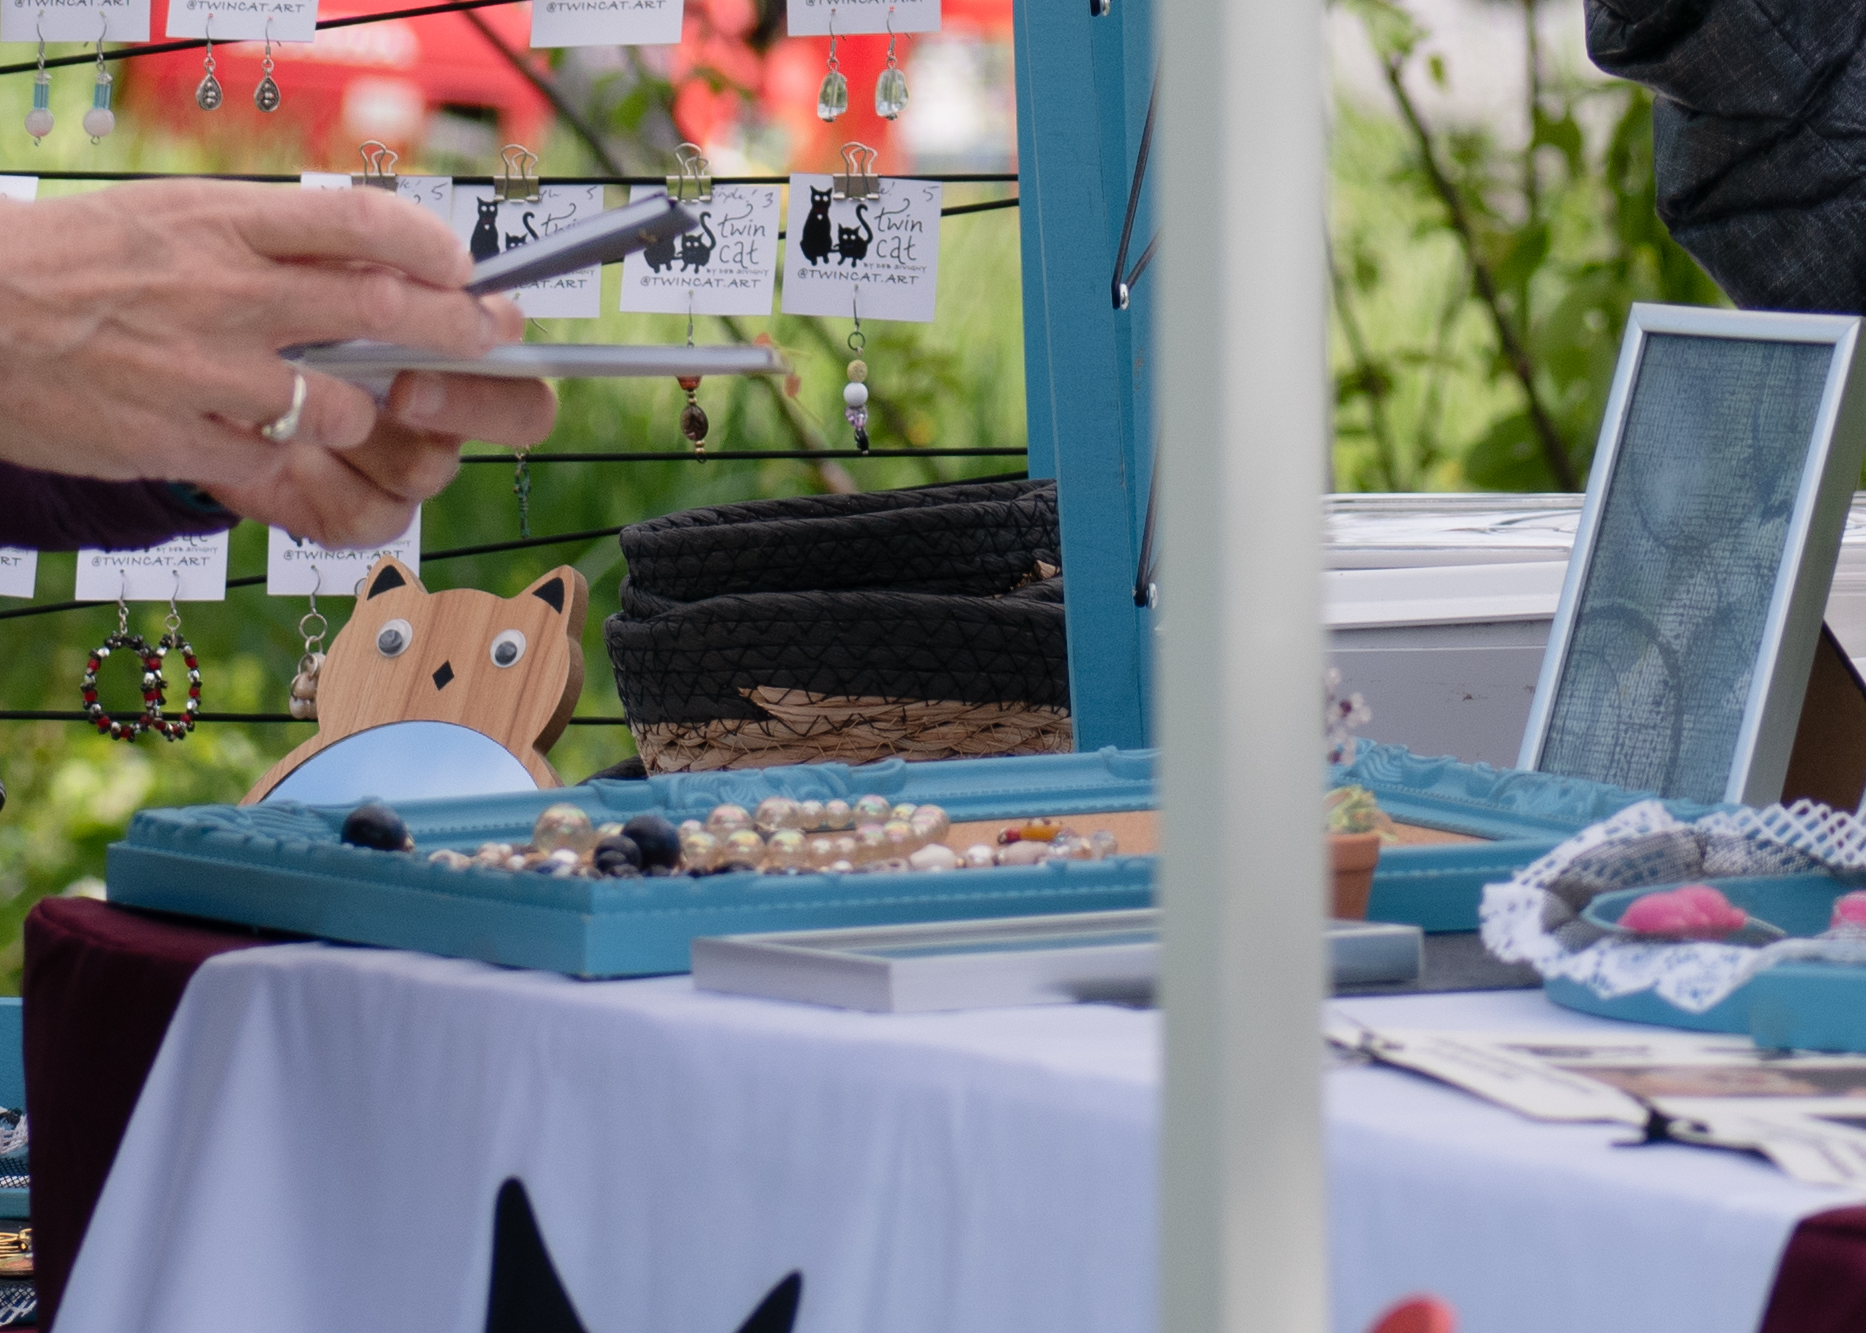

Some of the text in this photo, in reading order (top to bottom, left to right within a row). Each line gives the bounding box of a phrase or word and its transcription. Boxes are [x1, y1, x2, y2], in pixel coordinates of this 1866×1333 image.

[186, 0, 305, 13] @TWINCAT.ART
[545, 0, 666, 13] @TWINCAT.ART
[431, 182, 449, 200] 5
[586, 186, 598, 200] 5
[763, 191, 774, 209] 3
[923, 186, 939, 202] 5
[716, 203, 766, 239] twin
[873, 197, 923, 233] twin
[718, 239, 759, 270] cat
[875, 234, 917, 266] cat
[640, 275, 761, 288] @TWINCAT.ART
[797, 267, 919, 285] @TWINCAT.ART
[91, 555, 211, 568] @TWINCAT.ART
